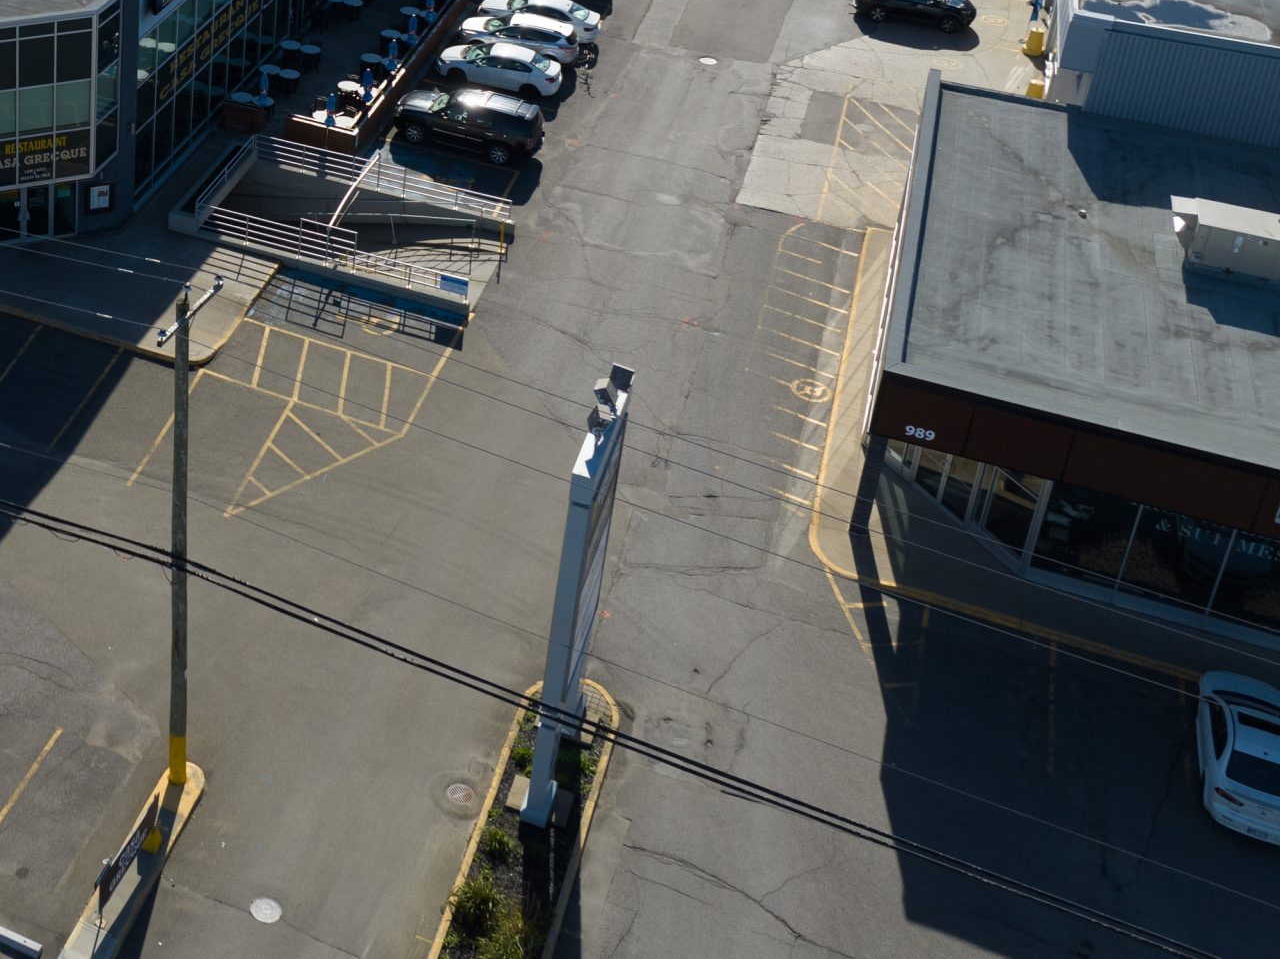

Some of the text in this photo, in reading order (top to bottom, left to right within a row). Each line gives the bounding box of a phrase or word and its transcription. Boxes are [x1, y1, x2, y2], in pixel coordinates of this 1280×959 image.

[159, 60, 196, 100] CASA
[4, 136, 68, 155] RESTAURANT
[24, 147, 87, 165] GRECQUE
[904, 425, 936, 441] 989
[1155, 518, 1171, 532] &
